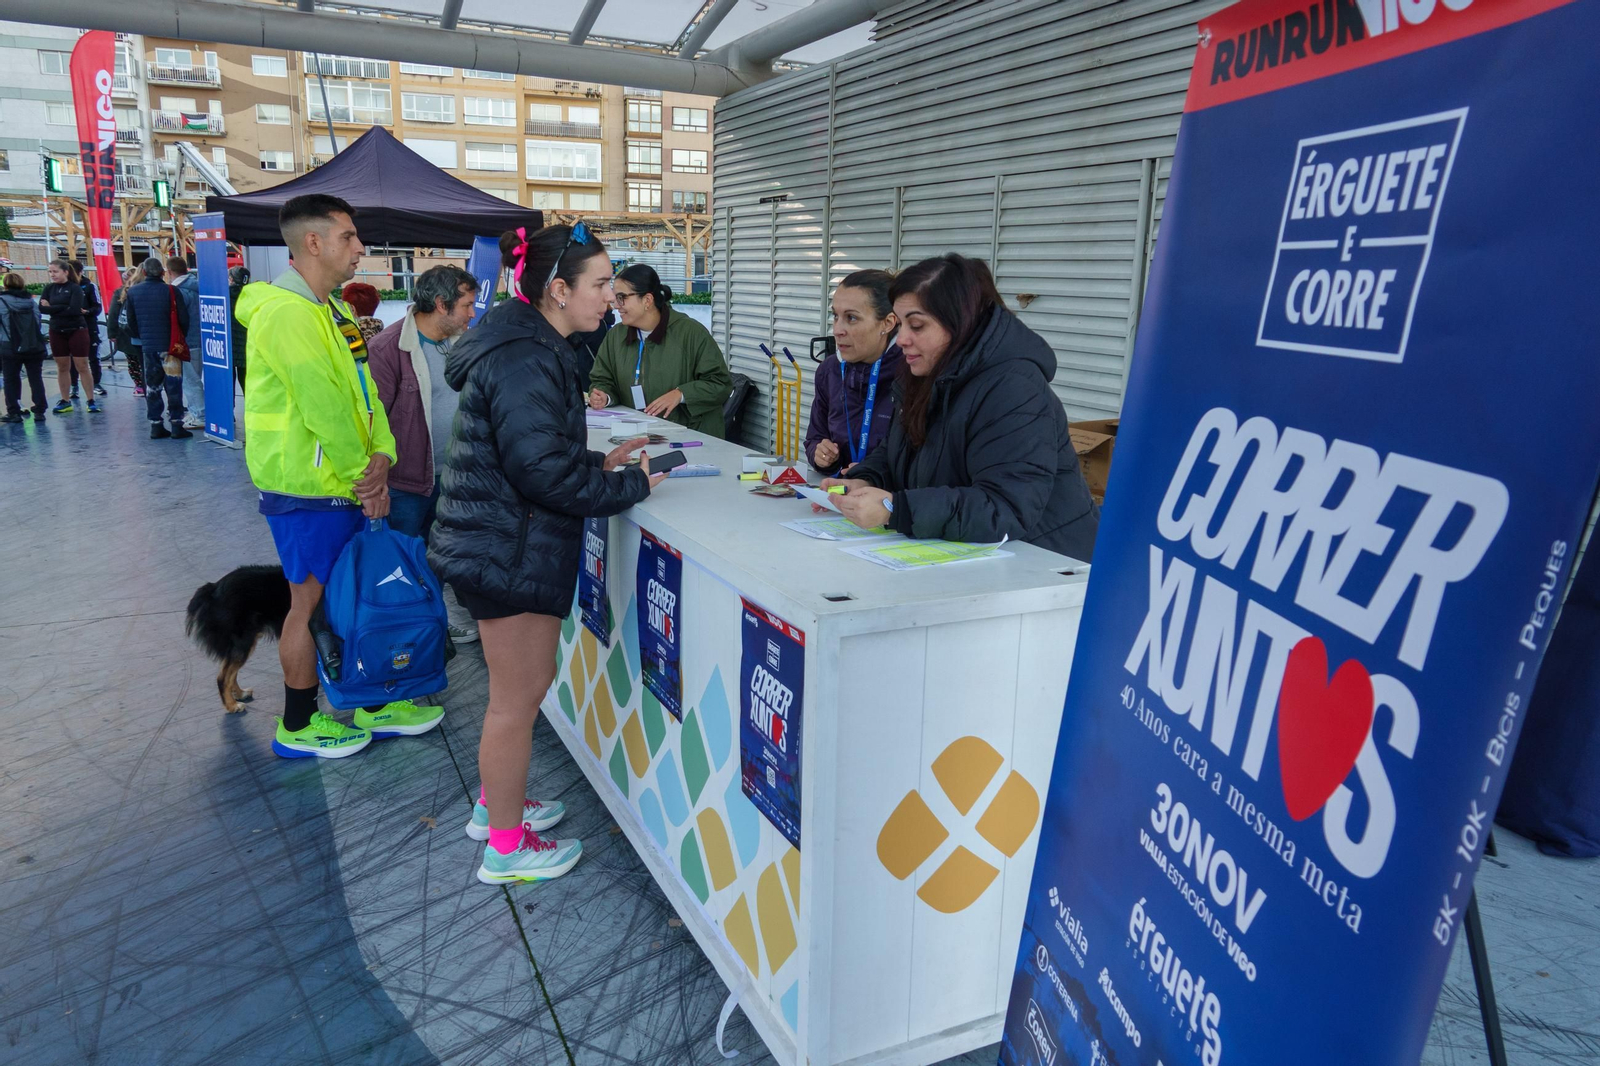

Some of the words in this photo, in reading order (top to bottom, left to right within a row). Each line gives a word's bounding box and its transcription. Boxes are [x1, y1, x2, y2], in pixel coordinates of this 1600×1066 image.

[1290, 143, 1447, 220] ÉRGUETE
[1340, 225, 1358, 262] E
[200, 299, 225, 325] ÉRGUETE
[1285, 268, 1397, 330] CORRE
[205, 338, 225, 360] CORRE
[1157, 407, 1509, 671] CORRER
[646, 578, 677, 618] CORRER
[750, 664, 794, 720] CORRER
[1120, 684, 1135, 710] 40
[1134, 697, 1171, 744] Anos
[1173, 736, 1209, 782] cara
[1211, 772, 1222, 795] a
[1225, 784, 1297, 867] mesma
[1300, 856, 1363, 934] meta
[1433, 894, 1458, 946] 5K
[1457, 799, 1487, 863] 10K
[1060, 900, 1089, 956] vialia
[1140, 828, 1168, 873] VIALIA
[1167, 863, 1213, 928] ESTACIÓN
[1212, 919, 1228, 947] DE
[1227, 936, 1257, 982] VIGO
